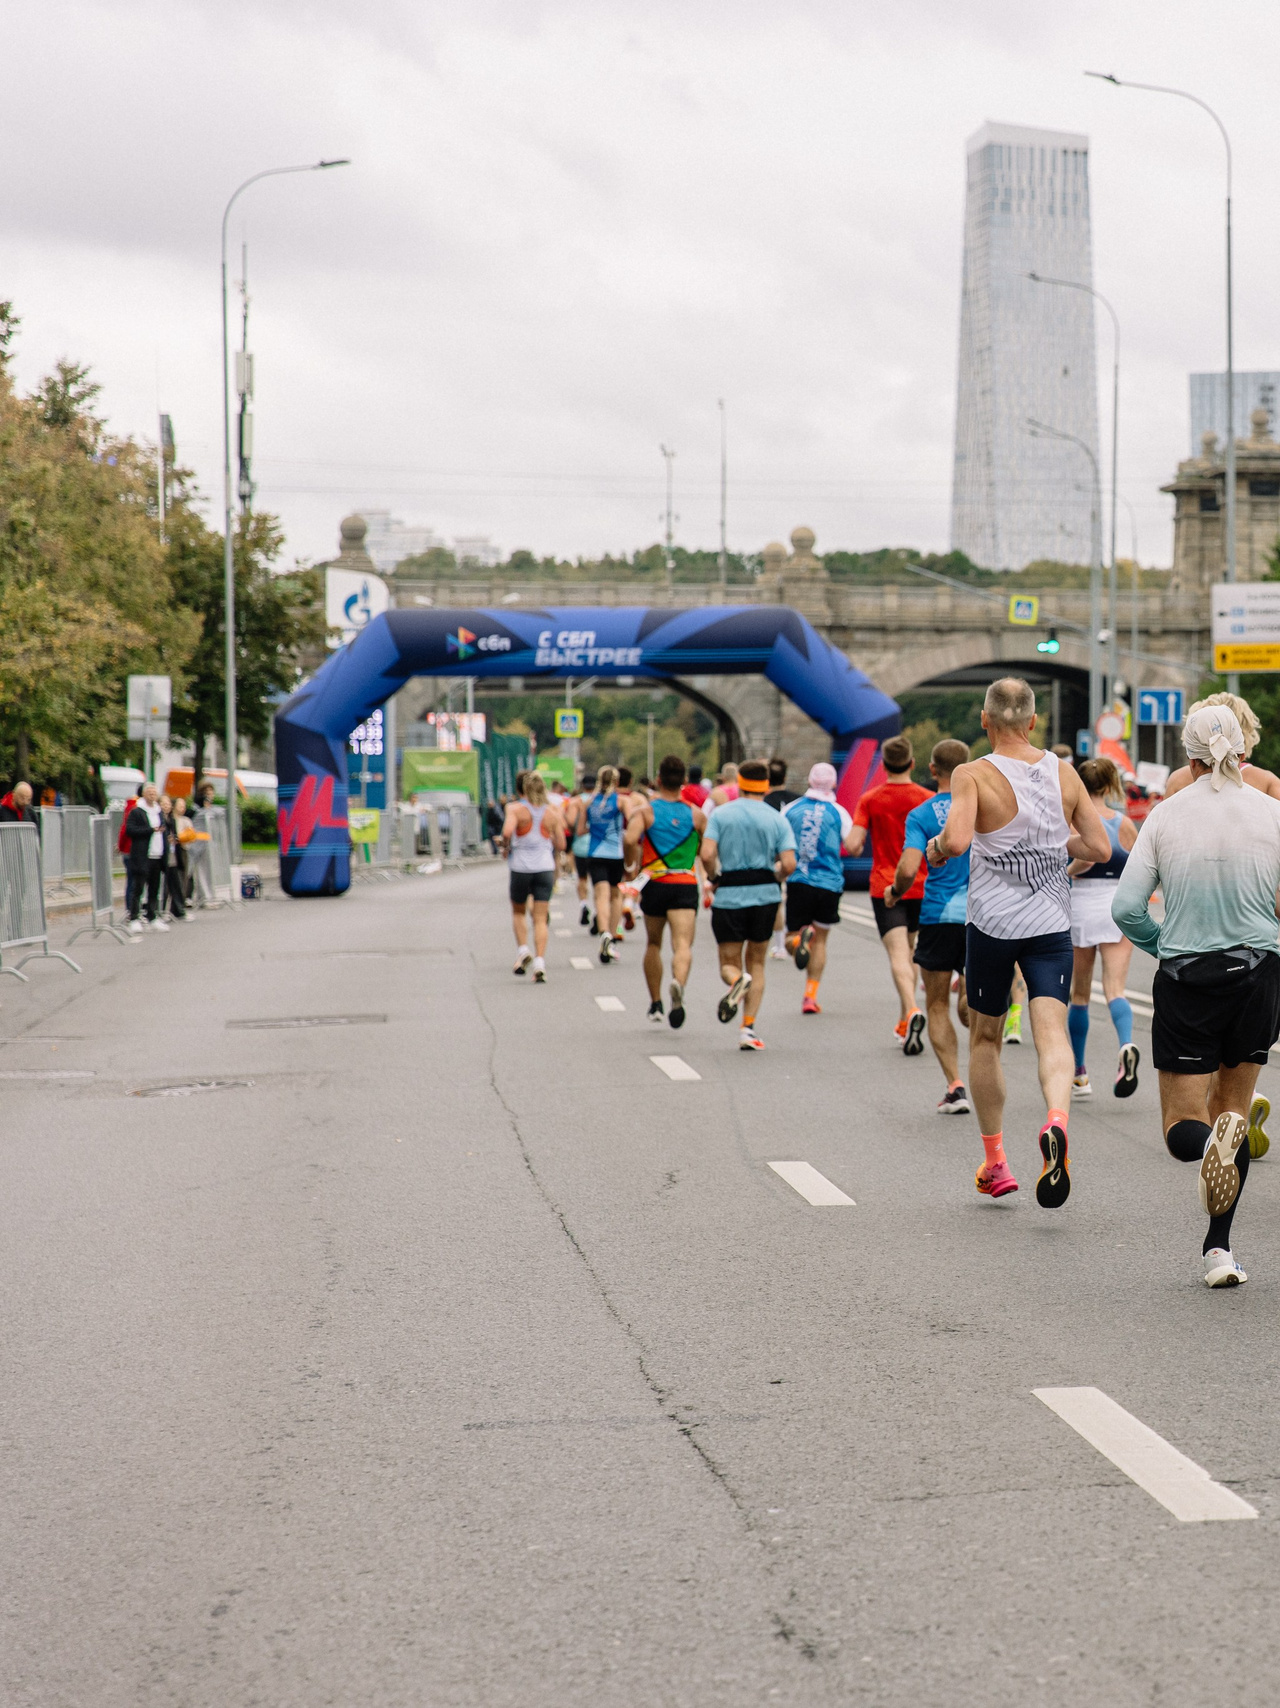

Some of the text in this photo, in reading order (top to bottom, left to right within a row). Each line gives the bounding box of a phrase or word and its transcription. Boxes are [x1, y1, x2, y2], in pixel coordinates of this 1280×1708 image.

[477, 634, 512, 651] сбп
[538, 630, 597, 648] С СБП
[535, 648, 643, 667] БЫСТРЕЕ
